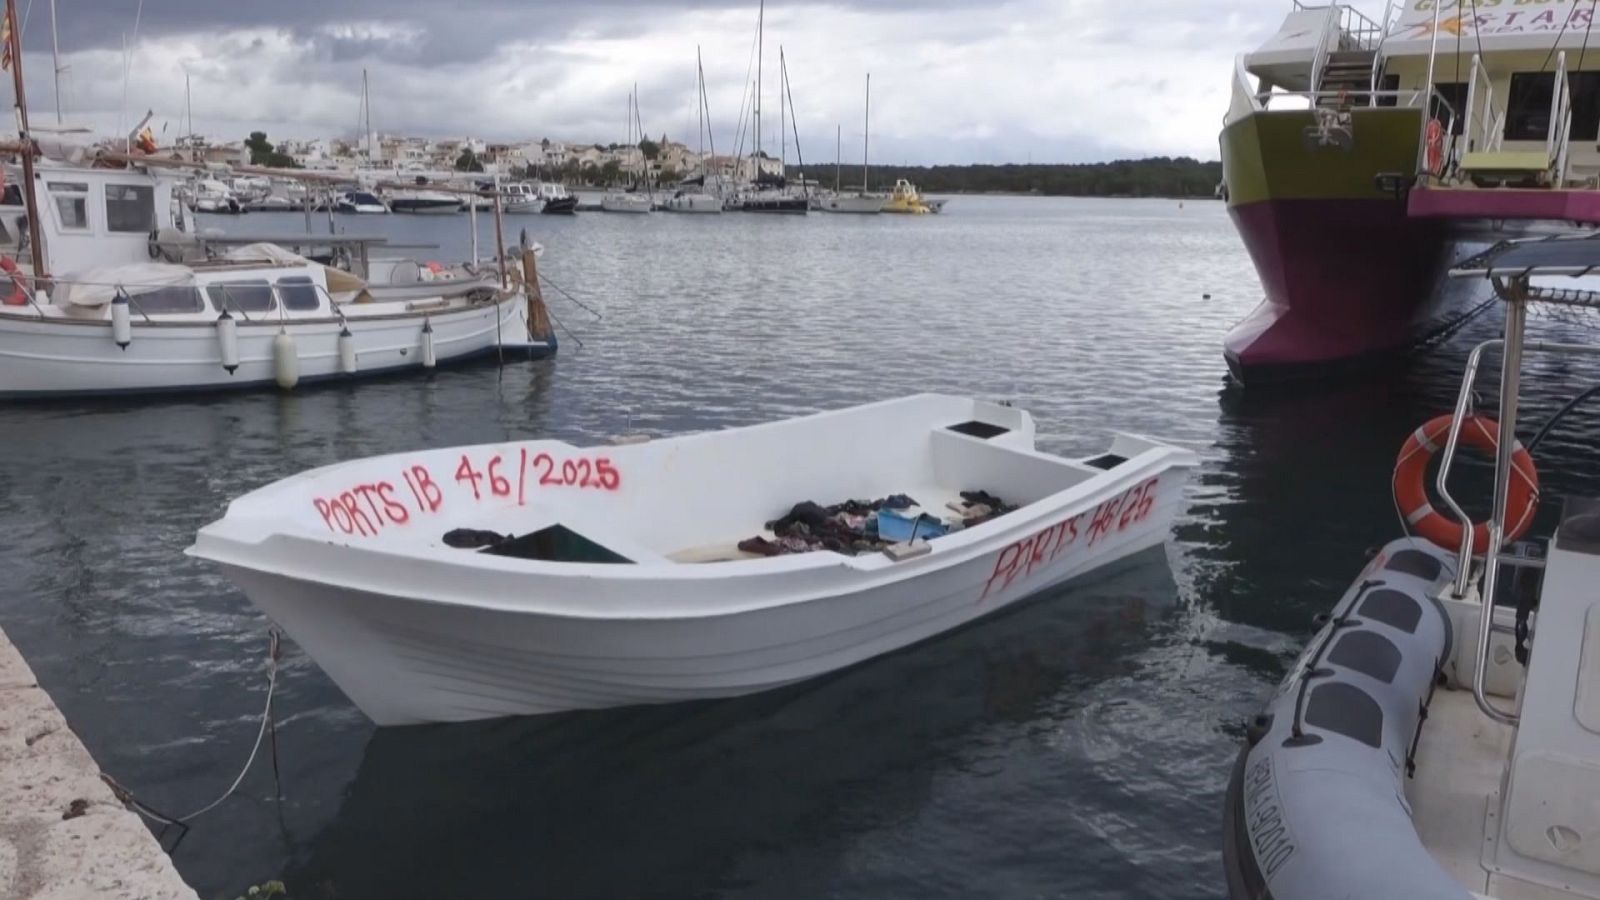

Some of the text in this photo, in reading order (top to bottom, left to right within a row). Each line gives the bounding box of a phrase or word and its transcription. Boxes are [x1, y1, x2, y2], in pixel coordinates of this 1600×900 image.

[1468, 9, 1593, 26] STAR
[1481, 25, 1524, 33] SEA
[313, 481, 410, 537] PORTS
[403, 465, 443, 512] IB
[975, 513, 1085, 605] PORTS
